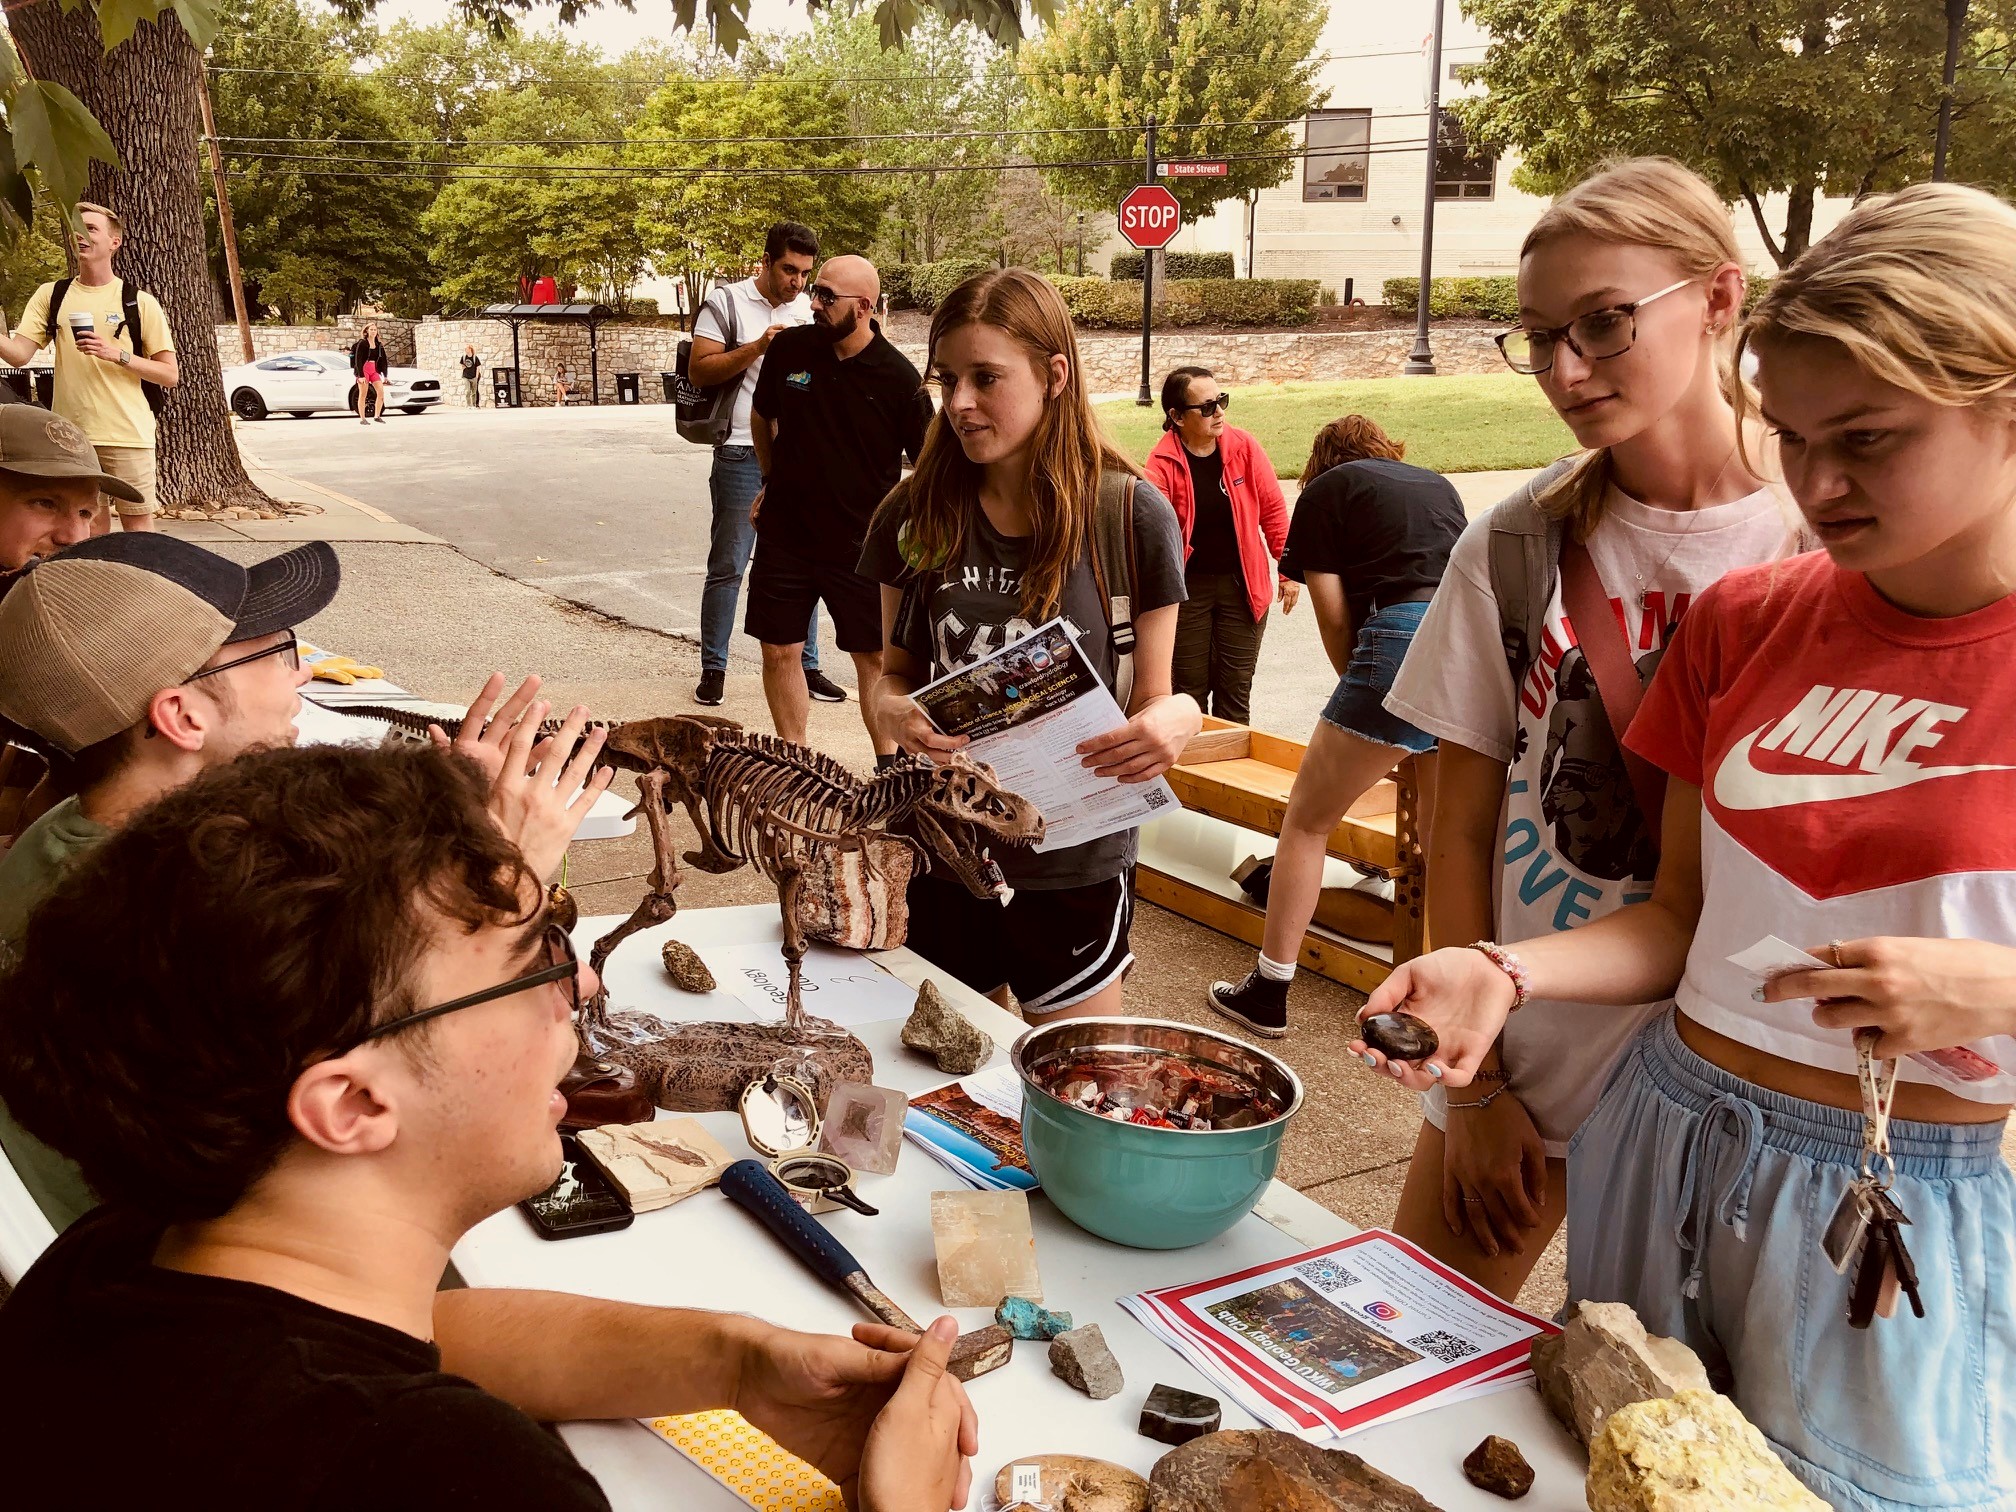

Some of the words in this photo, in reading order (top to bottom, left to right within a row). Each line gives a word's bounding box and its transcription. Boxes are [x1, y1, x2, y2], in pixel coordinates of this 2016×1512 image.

[1174, 164, 1194, 174] State
[1196, 164, 1220, 174] Street
[1124, 205, 1176, 228] STOP
[920, 676, 963, 703] Geological
[981, 709, 1003, 721] Science
[1008, 688, 1048, 711] GEOLOGICAL
[1047, 672, 1078, 693] SCIENCES
[1046, 688, 1067, 701] Geology
[1757, 684, 1970, 775] NIKE
[1504, 779, 1604, 932] OVE
[740, 968, 788, 1005] Geology
[924, 1106, 977, 1136] Sciences
[1418, 1274, 1441, 1290] Thursday
[1217, 1310, 1249, 1331] Club
[1407, 1305, 1432, 1320] Current
[1245, 1329, 1302, 1367] Geology
[1295, 1365, 1336, 1390] WKU
